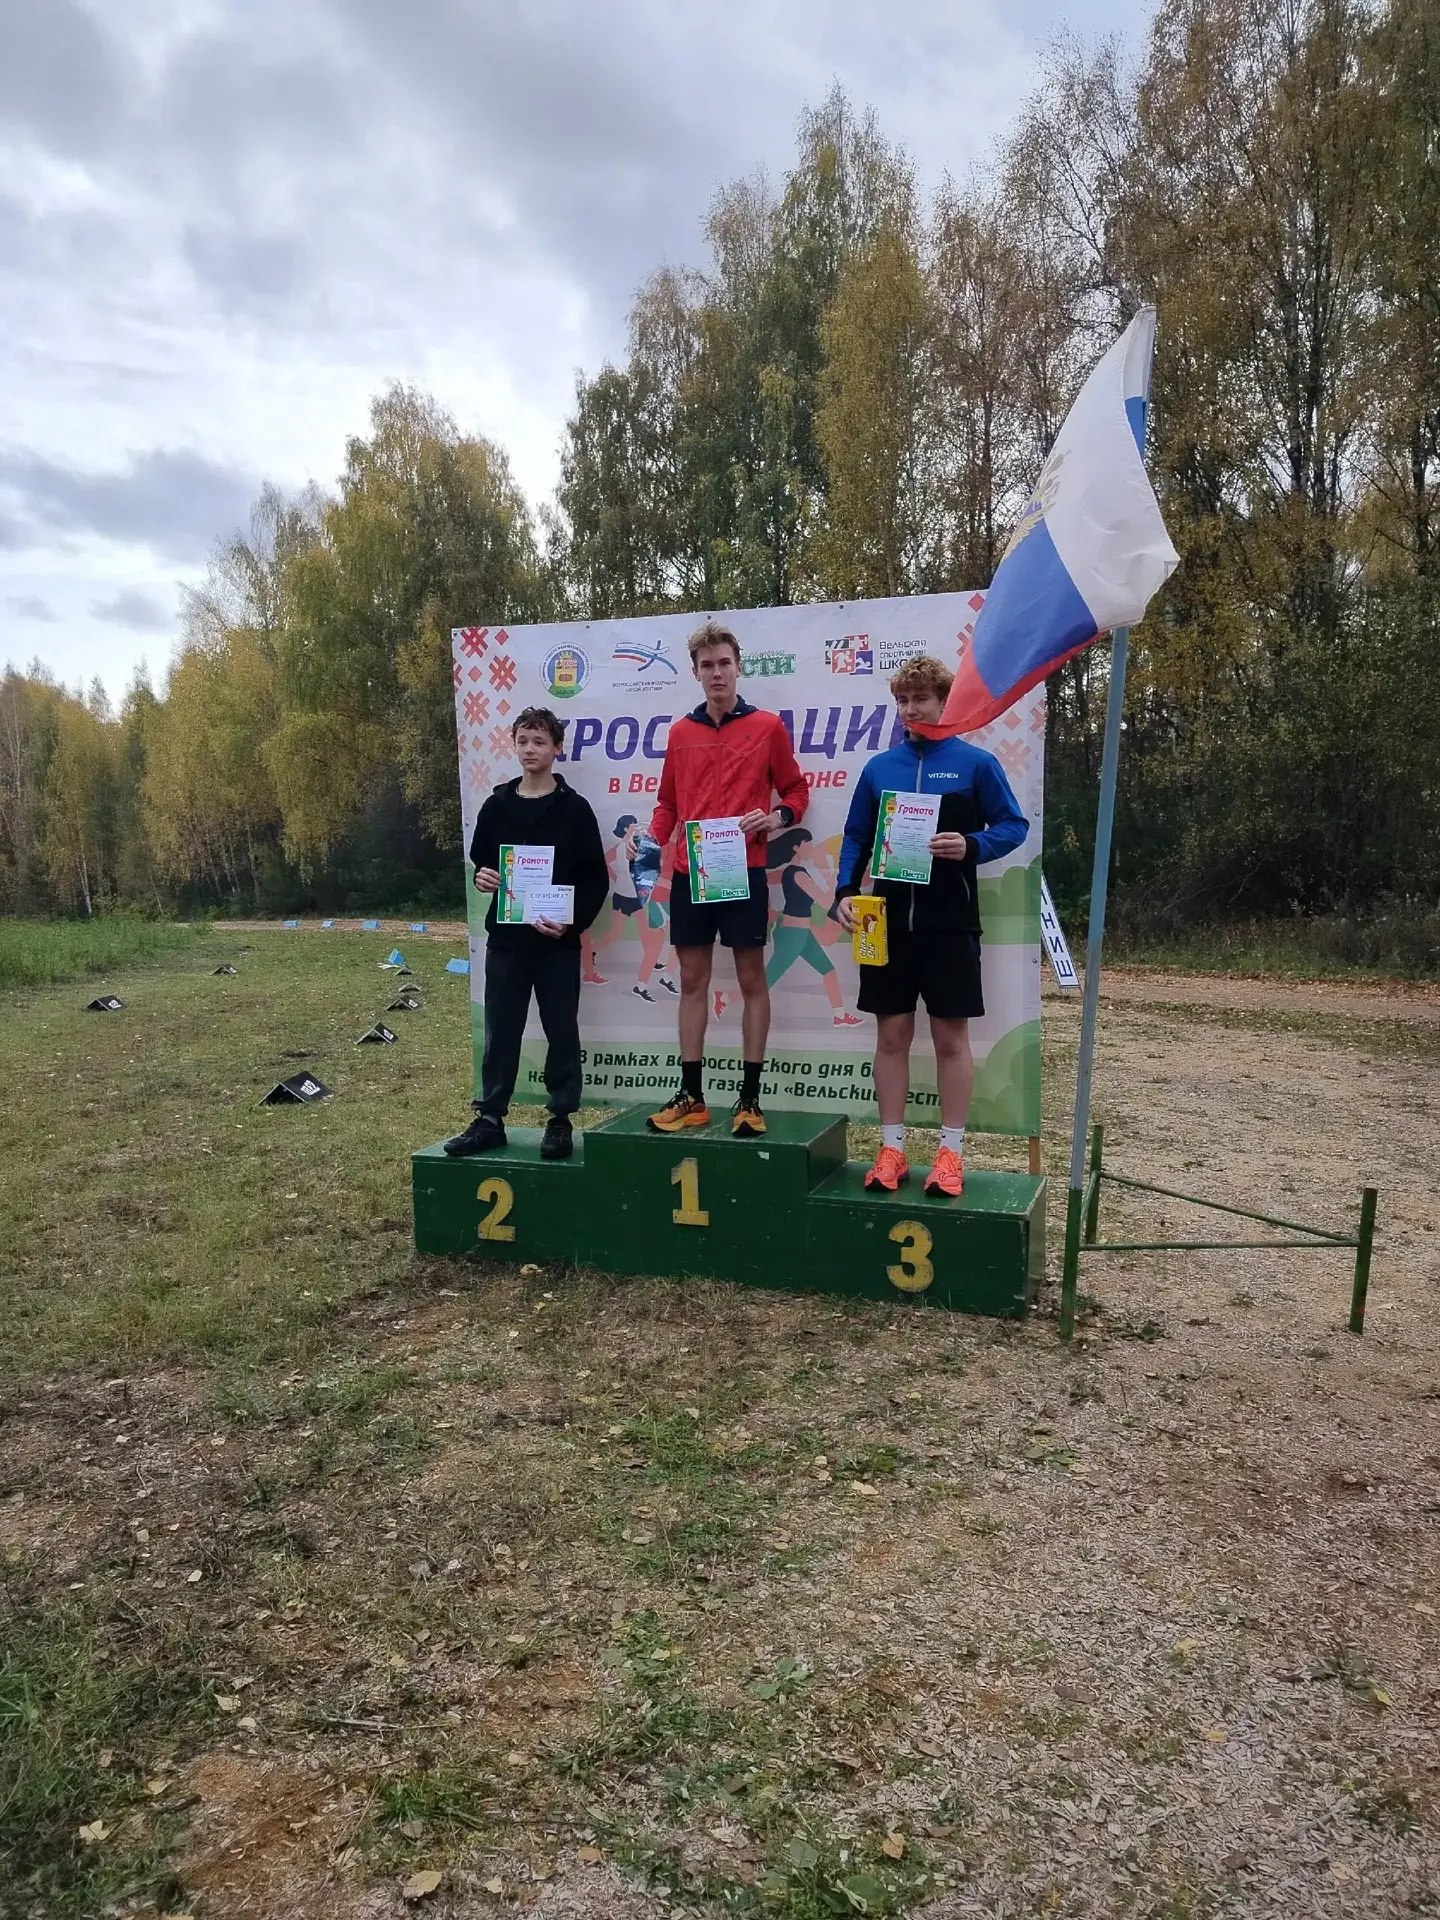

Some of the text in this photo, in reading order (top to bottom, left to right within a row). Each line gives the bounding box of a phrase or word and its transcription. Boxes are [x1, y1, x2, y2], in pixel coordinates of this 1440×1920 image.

[879, 640, 927, 650] Вельская
[741, 654, 797, 678] СТИ
[557, 715, 673, 762] РОС
[897, 804, 934, 816] Грамота
[705, 829, 739, 840] Грамота
[517, 856, 549, 865] Грамота
[593, 1052, 660, 1067] рамках
[613, 1073, 681, 1090] районн
[708, 1078, 778, 1095] газеы
[784, 1082, 877, 1102] «Вельски
[671, 1157, 710, 1226] 1
[476, 1176, 516, 1242] 2
[886, 1220, 935, 1293] 3
